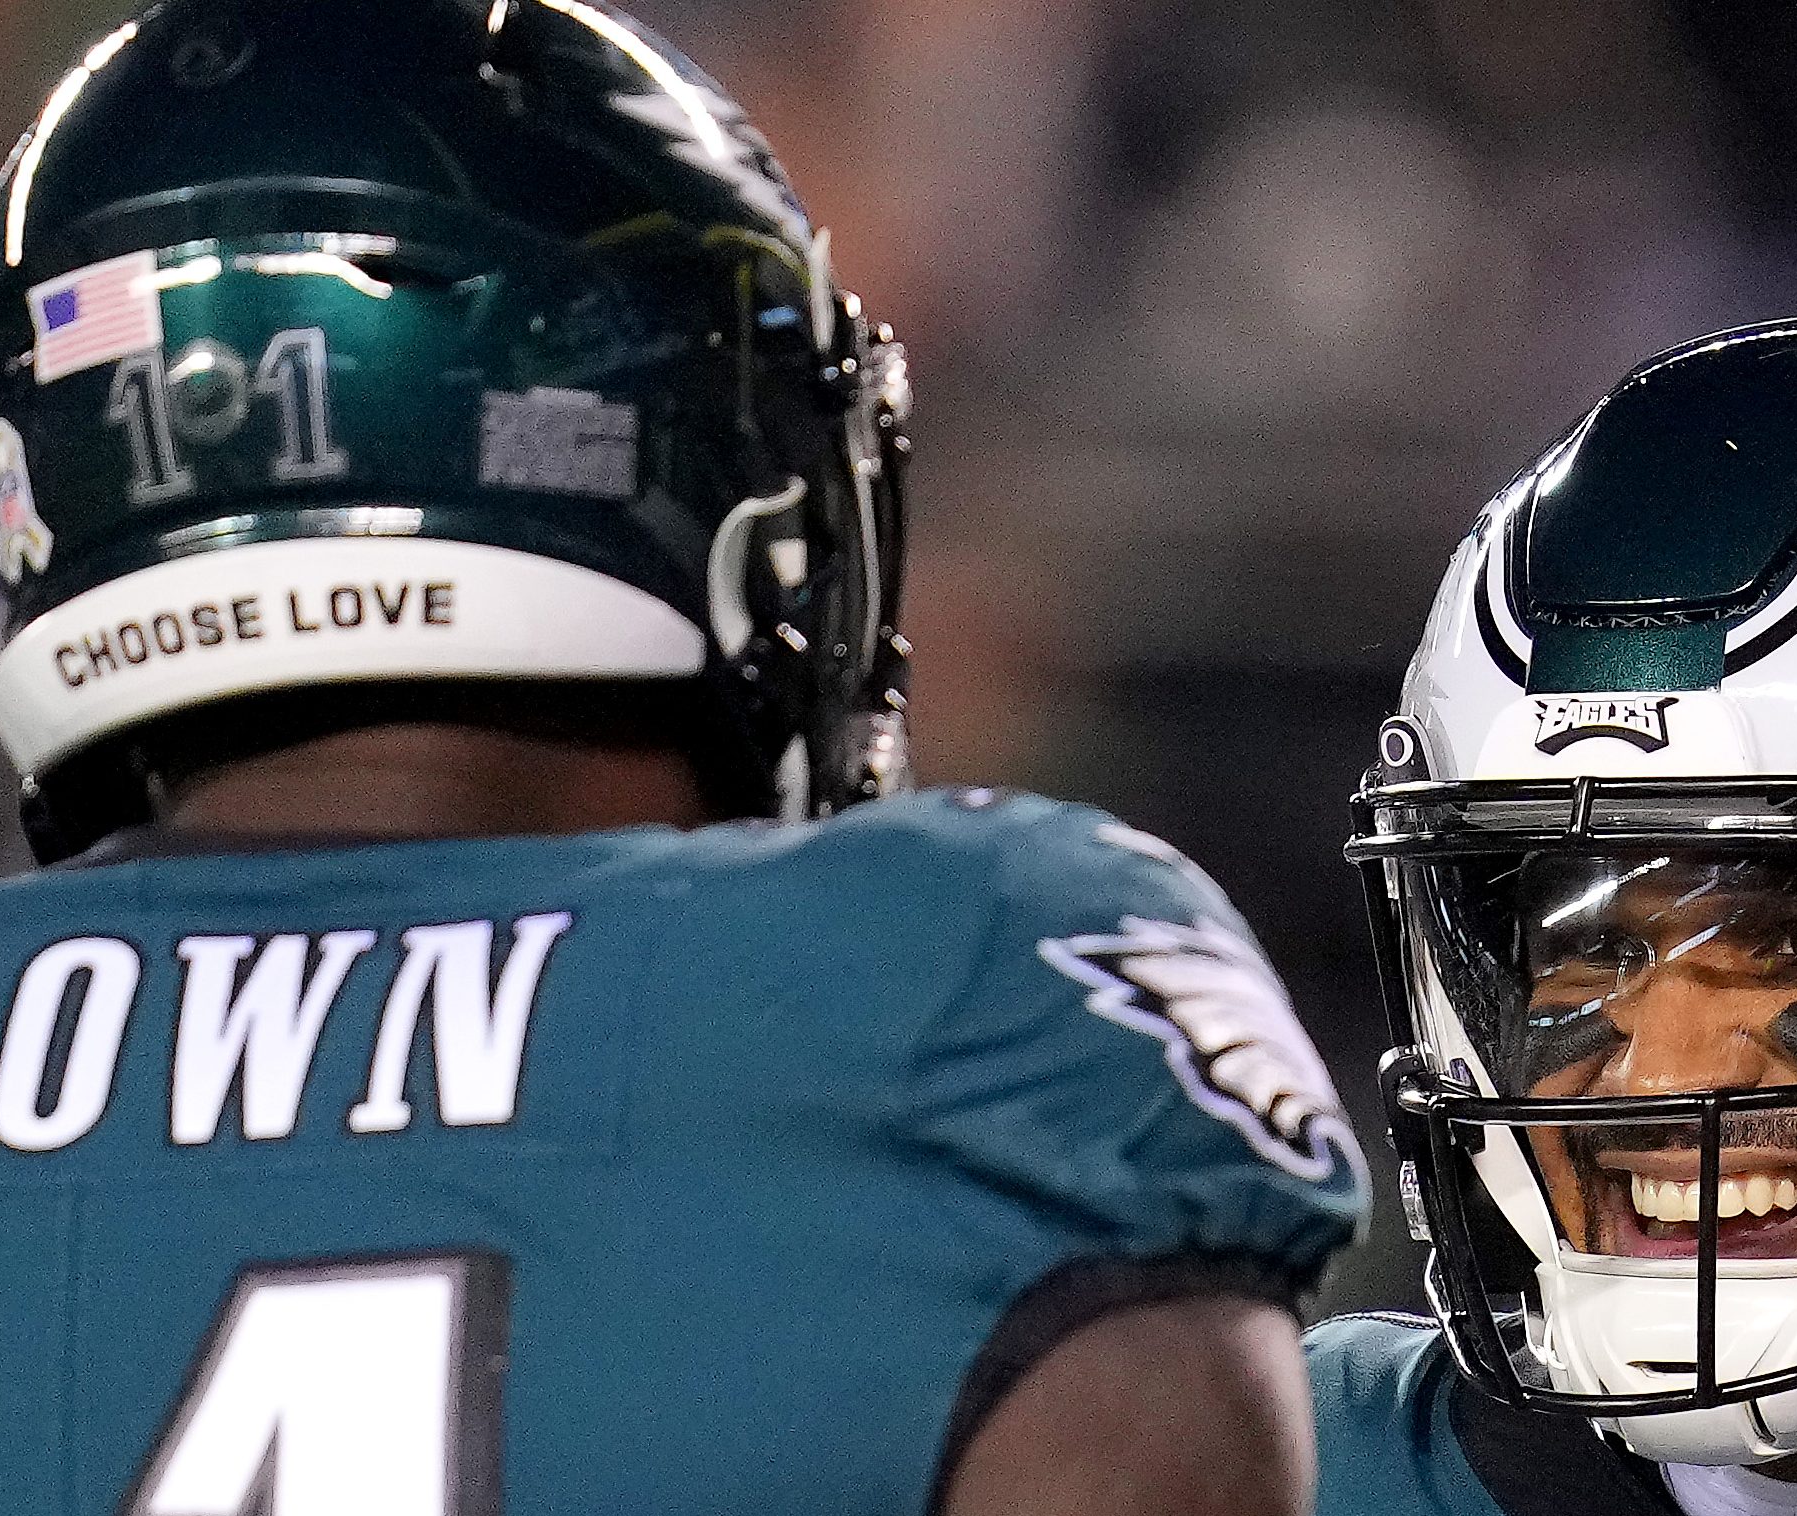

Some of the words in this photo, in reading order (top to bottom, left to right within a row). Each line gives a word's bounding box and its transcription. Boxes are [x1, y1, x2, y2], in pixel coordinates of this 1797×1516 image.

[106, 326, 352, 508] 11
[52, 593, 265, 690] CHOOSE
[287, 580, 458, 634] LOVE
[1535, 696, 1679, 752] EAGLES
